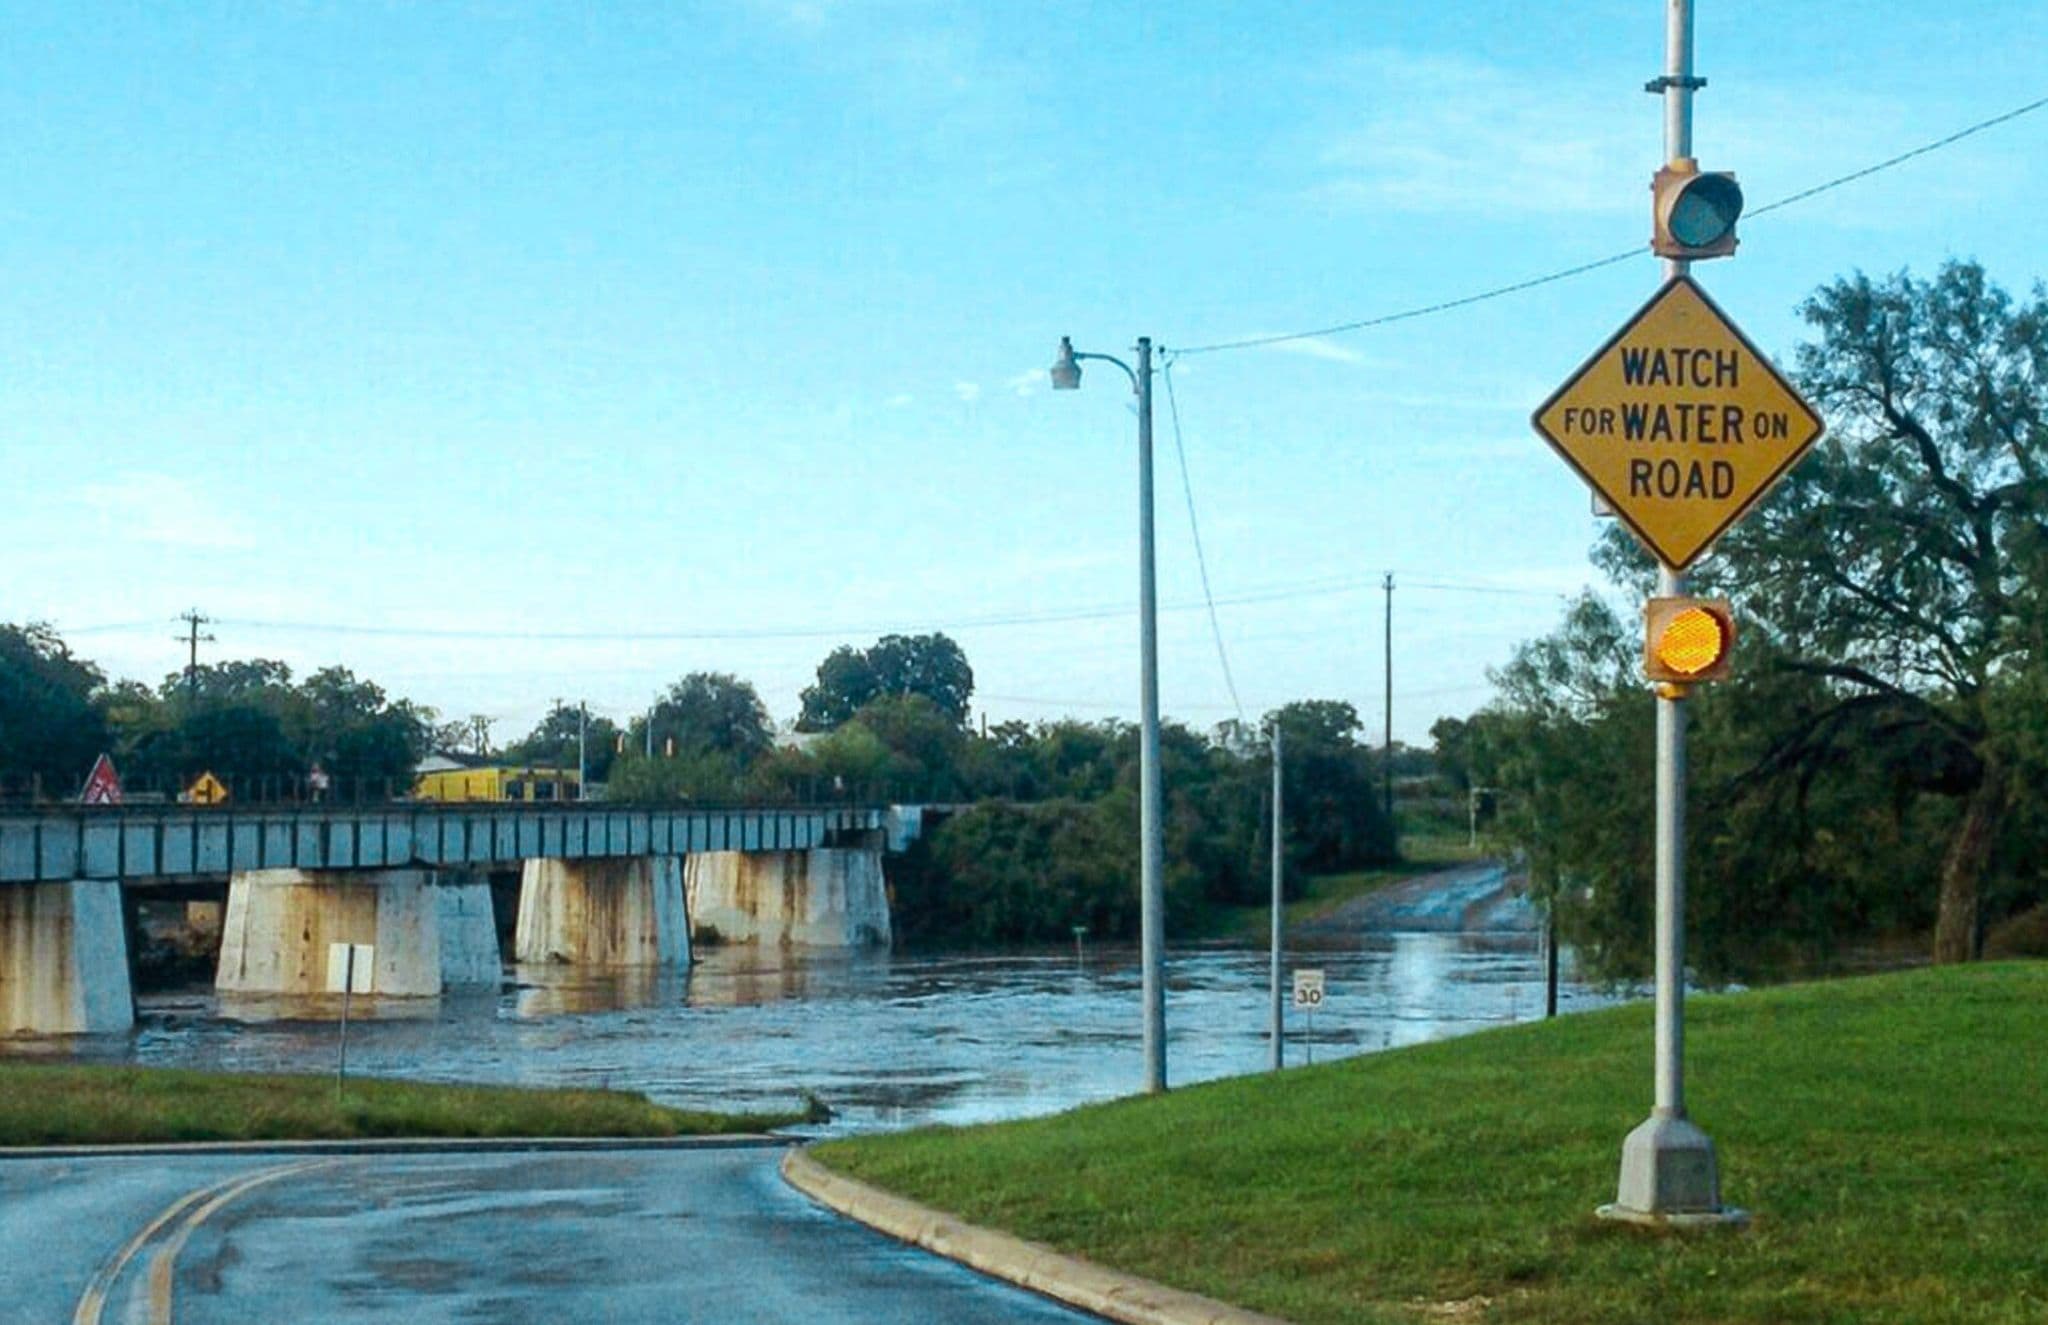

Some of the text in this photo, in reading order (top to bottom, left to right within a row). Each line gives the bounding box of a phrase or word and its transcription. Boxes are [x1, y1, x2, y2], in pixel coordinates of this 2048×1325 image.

[1620, 347, 1738, 388] WATCH
[1564, 403, 1788, 444] FOR WATER ON
[1630, 458, 1734, 499] ROAD
[1298, 989, 1321, 1004] 30
